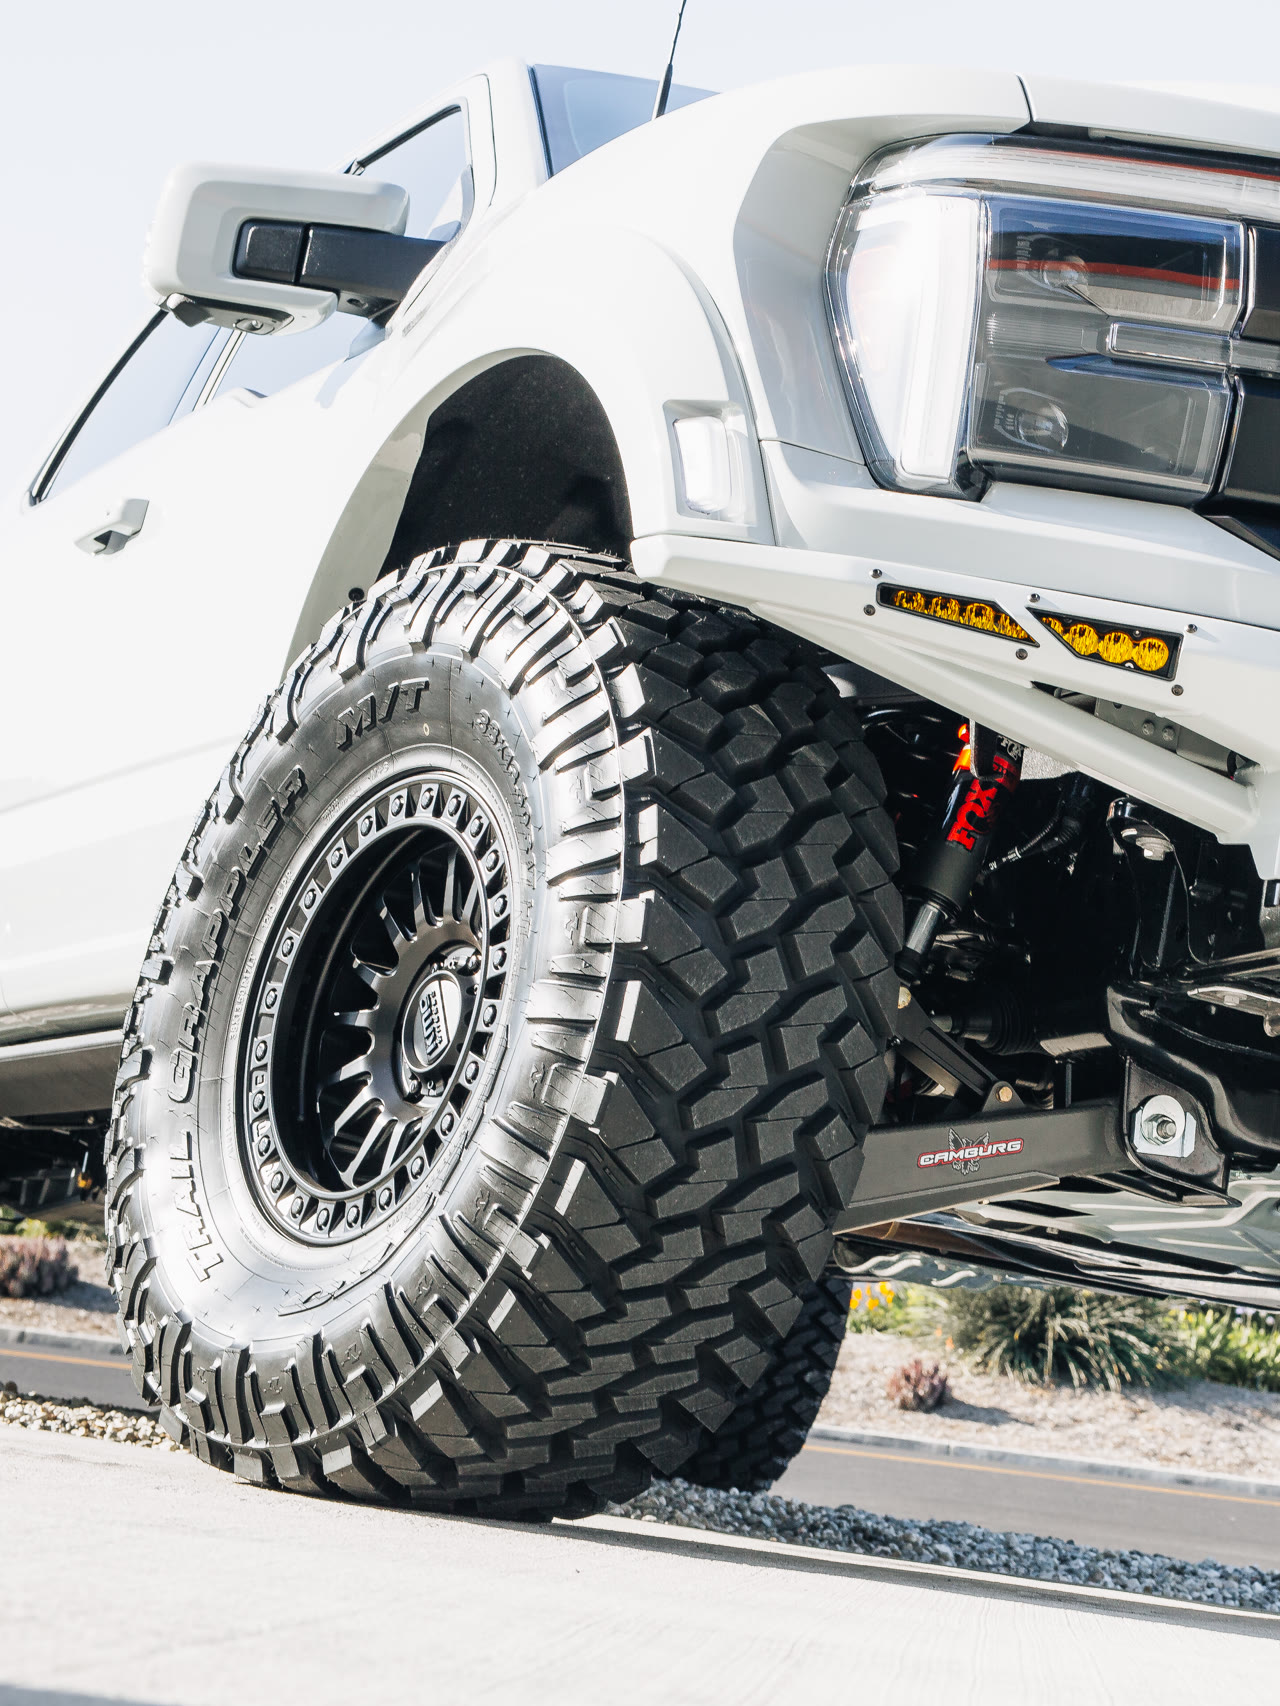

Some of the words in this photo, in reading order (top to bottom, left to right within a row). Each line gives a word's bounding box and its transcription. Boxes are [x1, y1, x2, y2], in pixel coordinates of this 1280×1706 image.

[335, 676, 430, 752] M/T
[946, 778, 999, 851] FOX
[166, 764, 309, 1104] GRAPPLER
[919, 1140, 1022, 1166] CAMBURG
[169, 1130, 225, 1283] TRAIL
